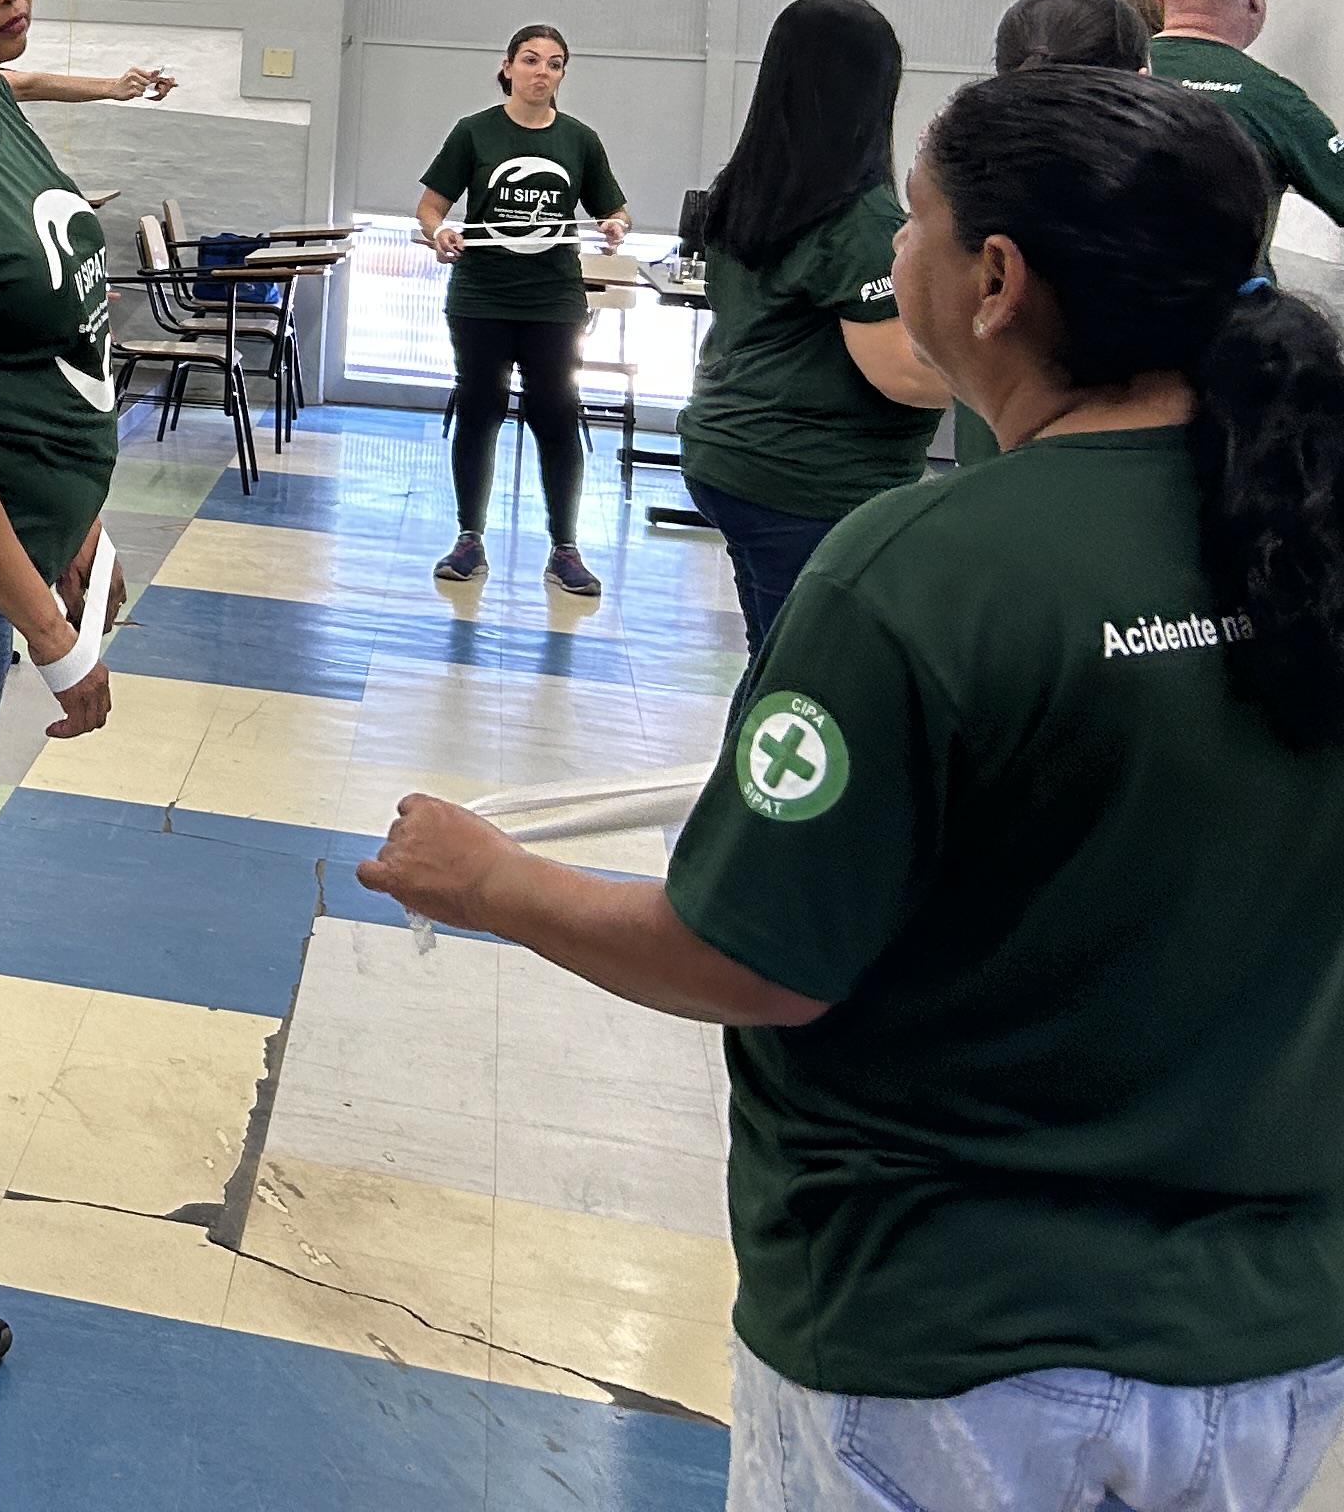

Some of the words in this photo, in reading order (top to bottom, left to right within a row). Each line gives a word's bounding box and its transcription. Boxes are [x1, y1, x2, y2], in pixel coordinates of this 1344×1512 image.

[499, 187, 510, 201] II
[513, 188, 562, 204] SIPAT
[860, 274, 894, 303] FUN
[1102, 611, 1218, 659] Acidente
[791, 698, 826, 729] CIPA
[743, 782, 784, 815] SIPAT
